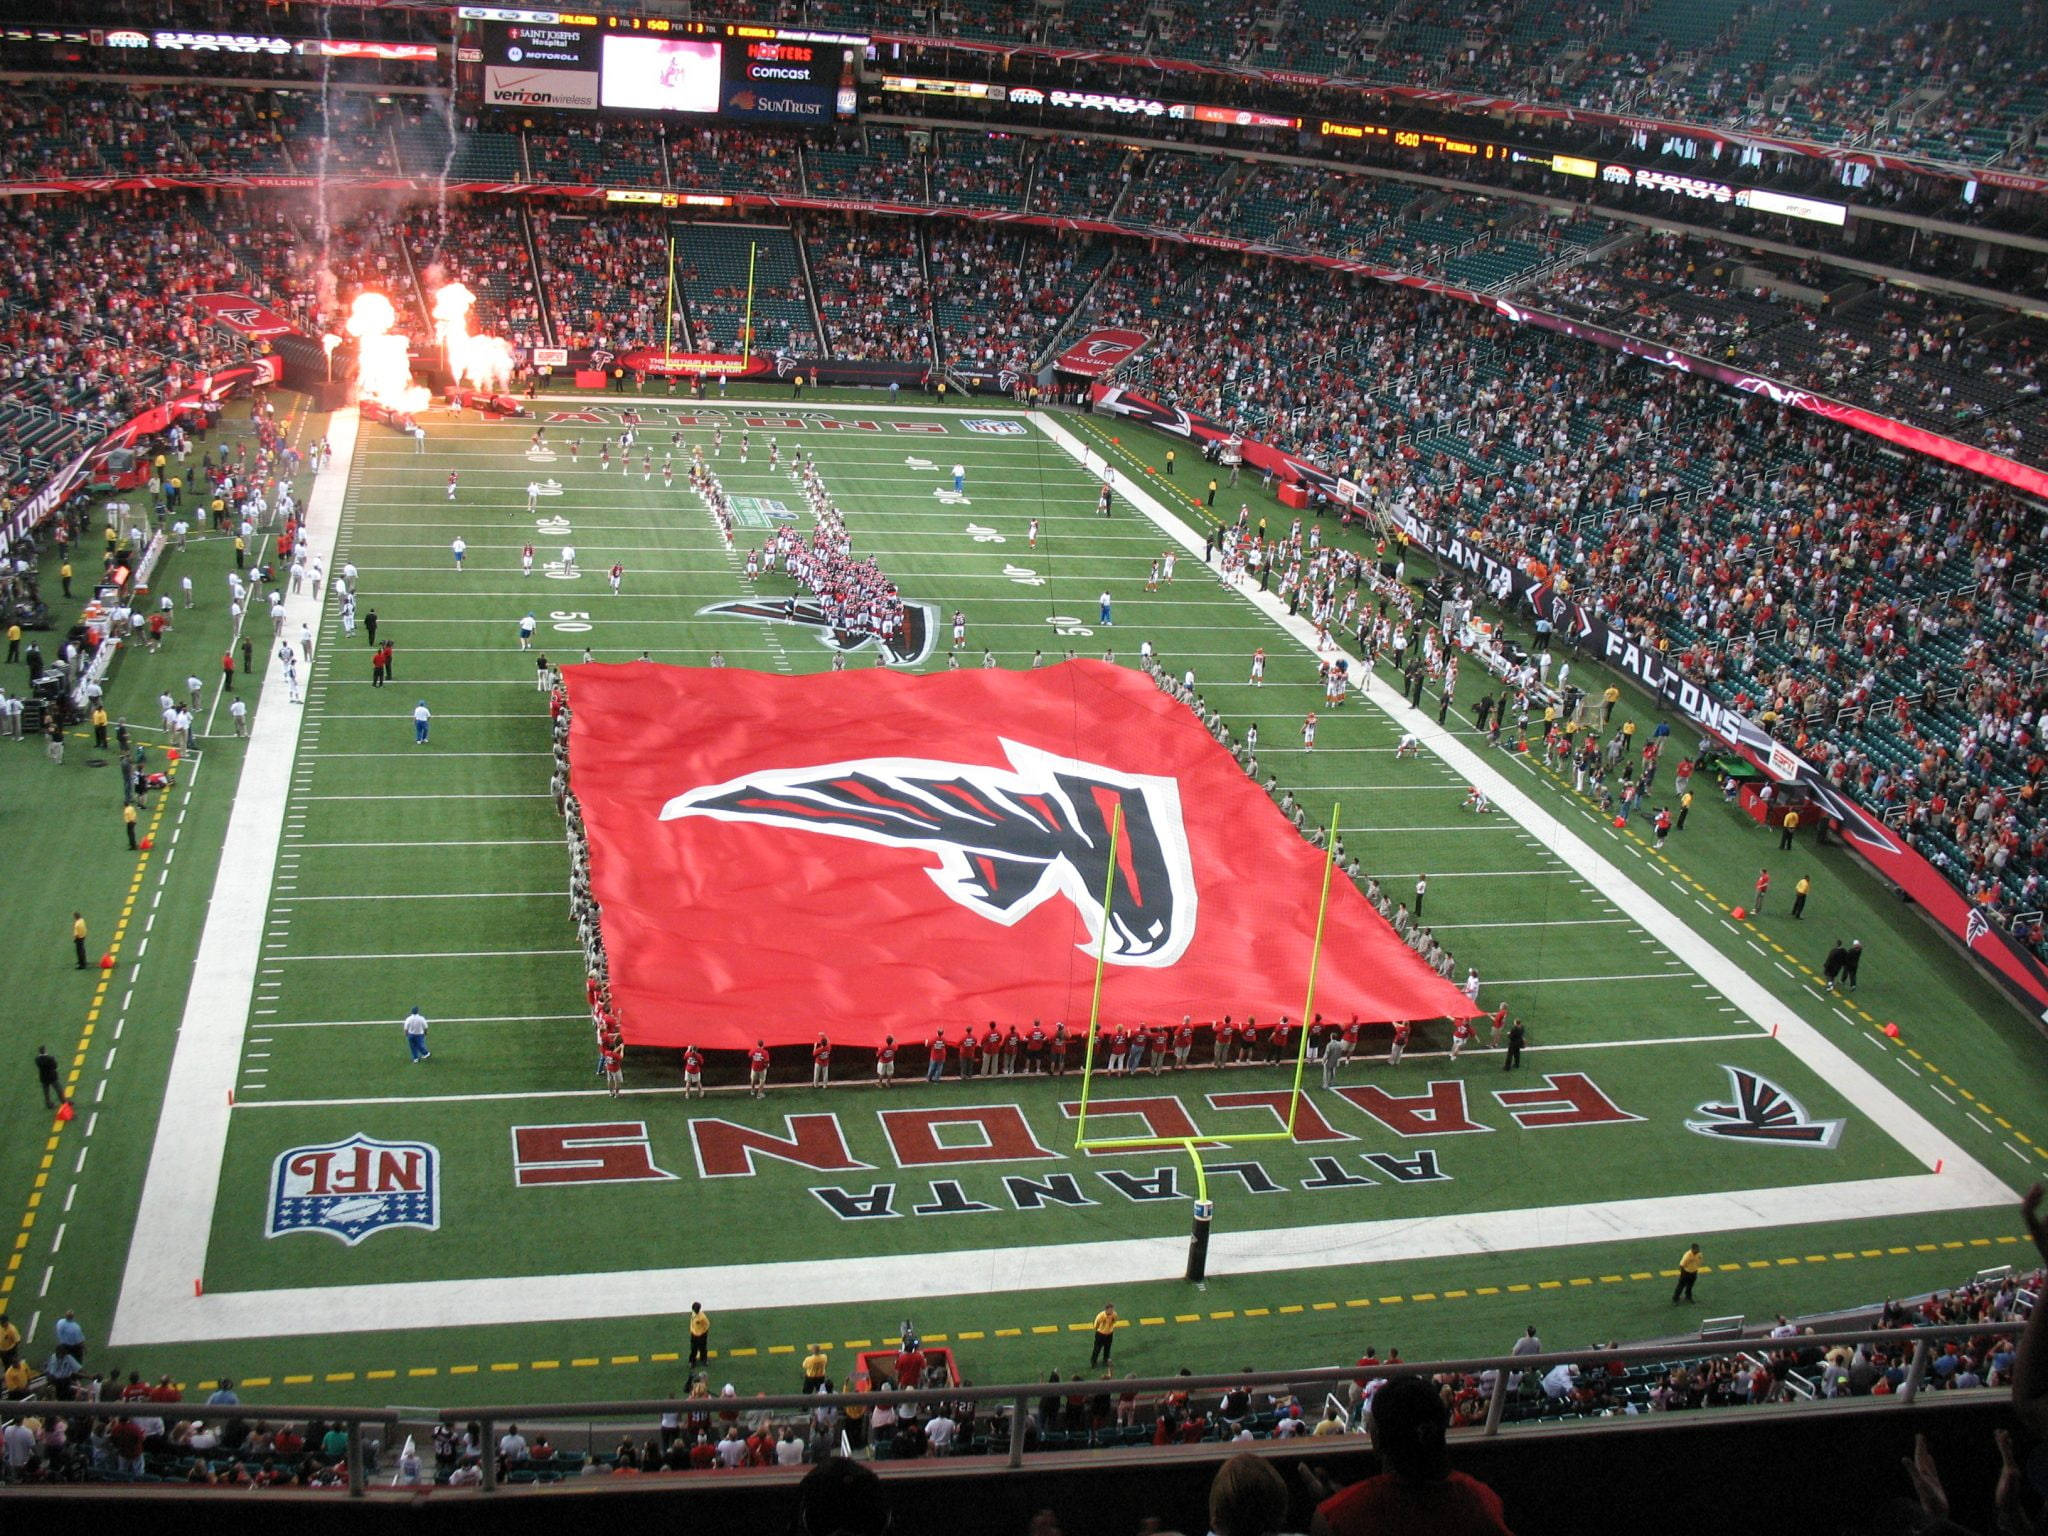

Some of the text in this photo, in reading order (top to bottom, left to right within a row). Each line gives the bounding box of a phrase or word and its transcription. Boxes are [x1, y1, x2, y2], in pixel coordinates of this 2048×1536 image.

[520, 29, 545, 39] SAINT
[532, 38, 568, 47] Hospital
[526, 52, 579, 61] MOTOROLA
[748, 43, 813, 61] HOOTERS
[494, 88, 592, 105] verizon wireless
[1330, 125, 1363, 137] FALCONS
[258, 179, 315, 187] FALCONS
[826, 202, 874, 210] FALCONS
[1192, 236, 1240, 249] FALCONS
[974, 424, 1021, 435] NFL
[1403, 515, 1513, 600] ATLANTA
[550, 610, 593, 632] 50
[1046, 615, 1094, 637] 50
[1605, 630, 1742, 745] FALCONS
[511, 1072, 1648, 1188] FALCONS
[291, 1147, 424, 1196] NFL
[808, 1149, 1454, 1220] ATLANTA
